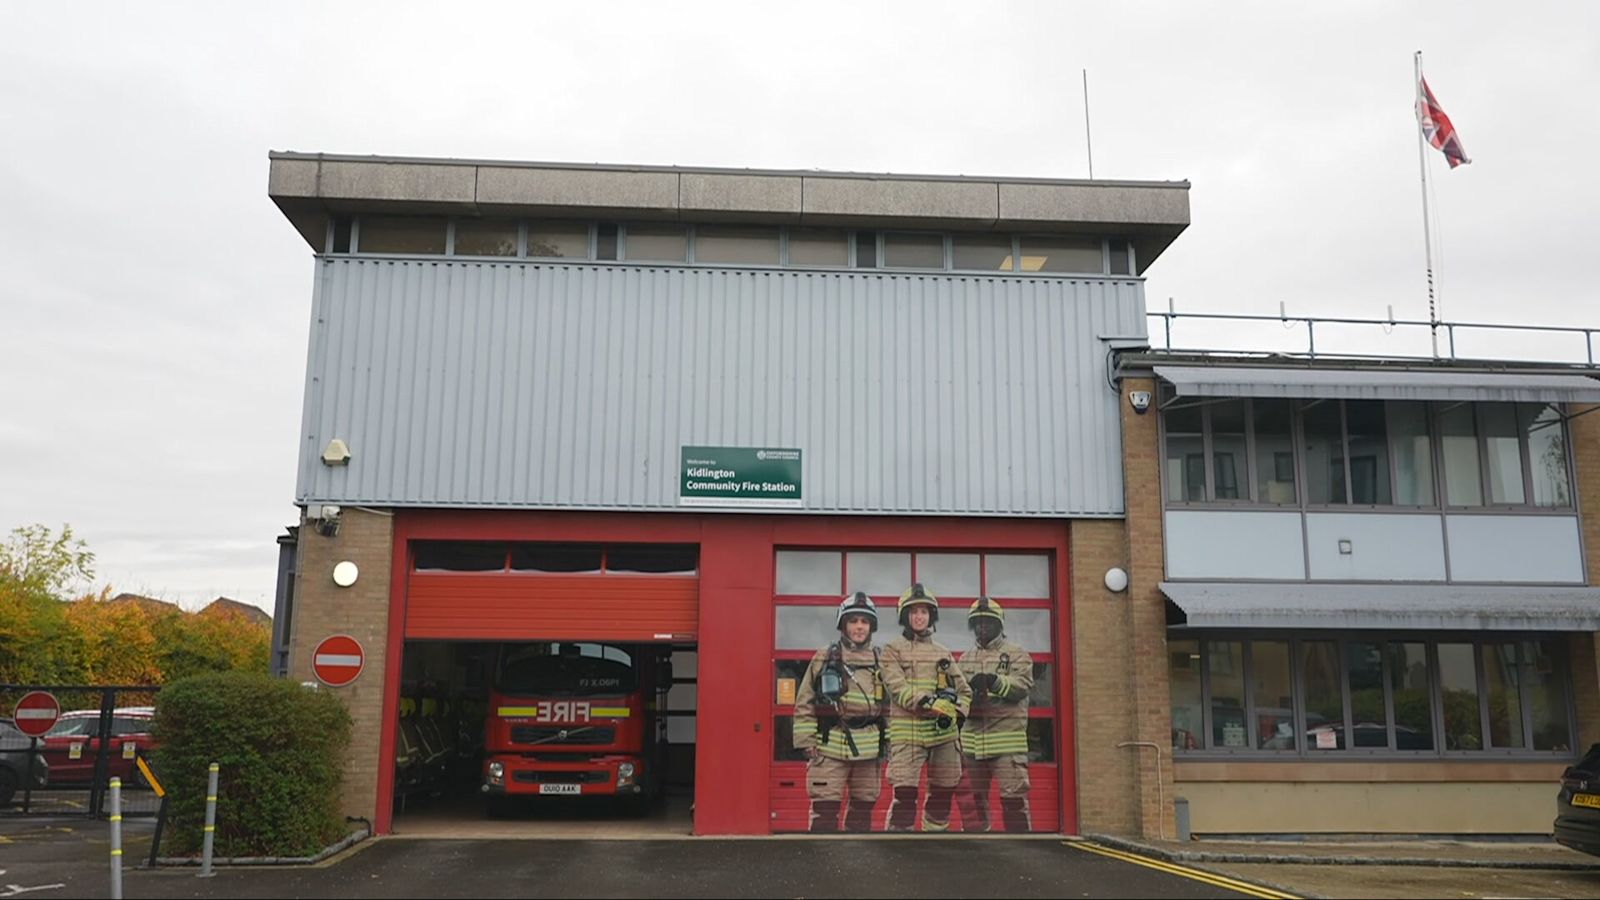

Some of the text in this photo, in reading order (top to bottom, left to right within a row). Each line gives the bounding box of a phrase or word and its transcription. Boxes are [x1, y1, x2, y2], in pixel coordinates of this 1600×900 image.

[687, 468, 735, 480] Kidlington
[686, 481, 796, 493] Community Fire Station
